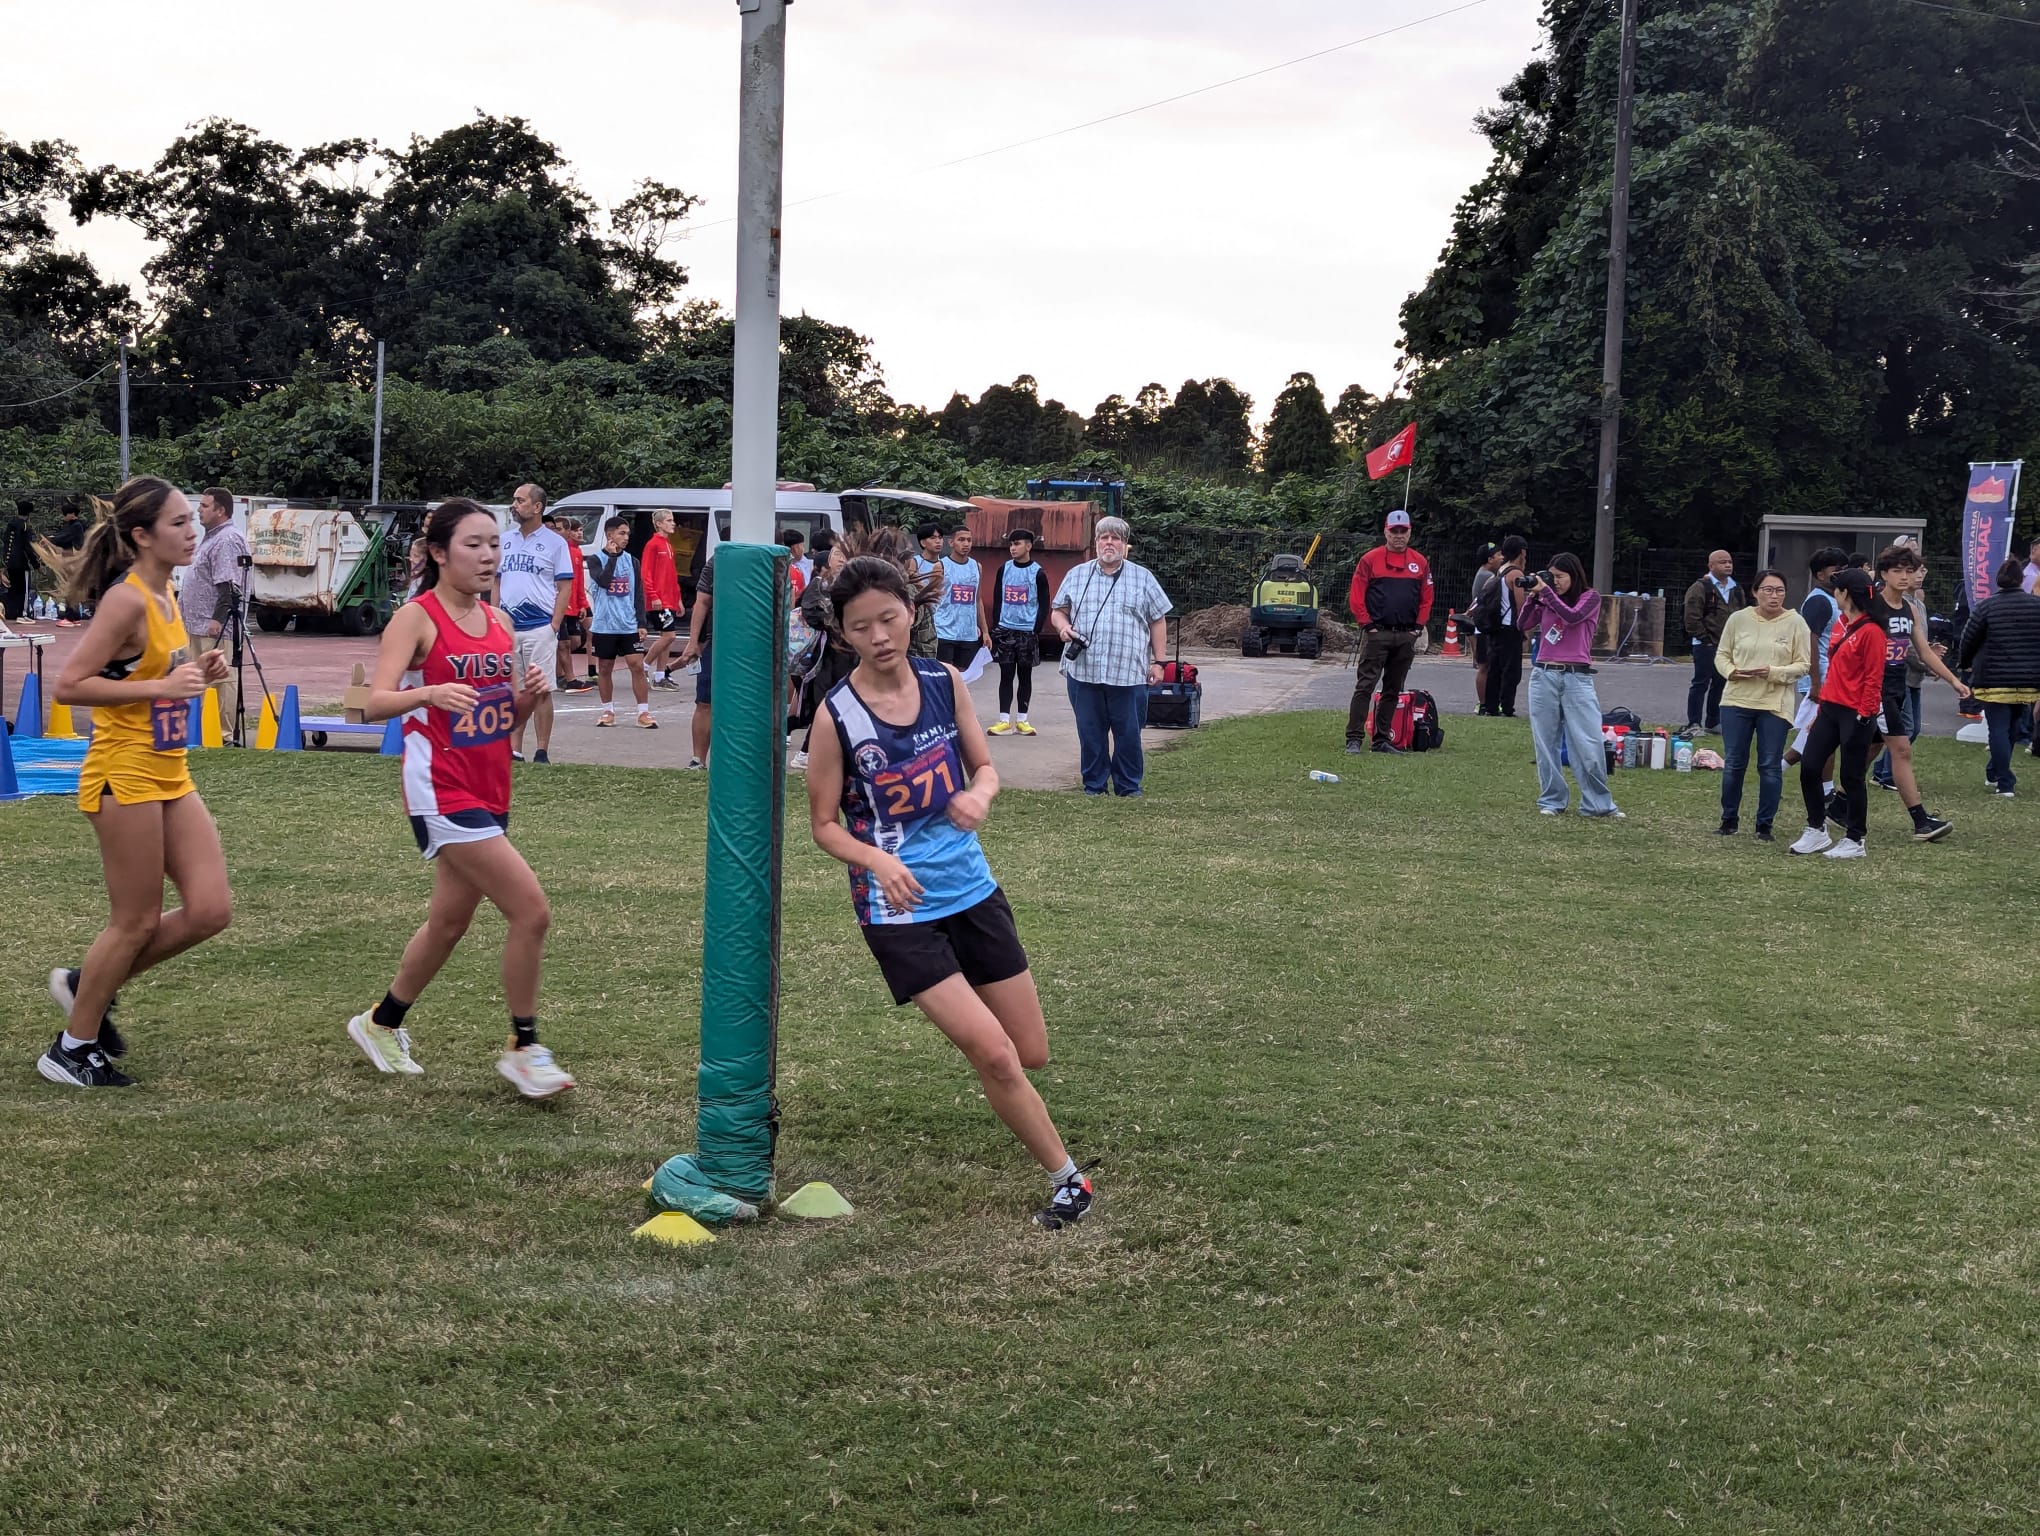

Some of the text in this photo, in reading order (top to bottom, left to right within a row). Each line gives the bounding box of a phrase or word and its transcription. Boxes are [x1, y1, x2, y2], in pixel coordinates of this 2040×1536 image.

[503, 553, 535, 566] FAITH
[501, 563, 544, 575] CADEMY
[953, 590, 974, 602] 331
[1005, 591, 1028, 603] 334
[445, 653, 513, 680] YISS
[453, 701, 515, 738] 405
[885, 761, 955, 816] 271
